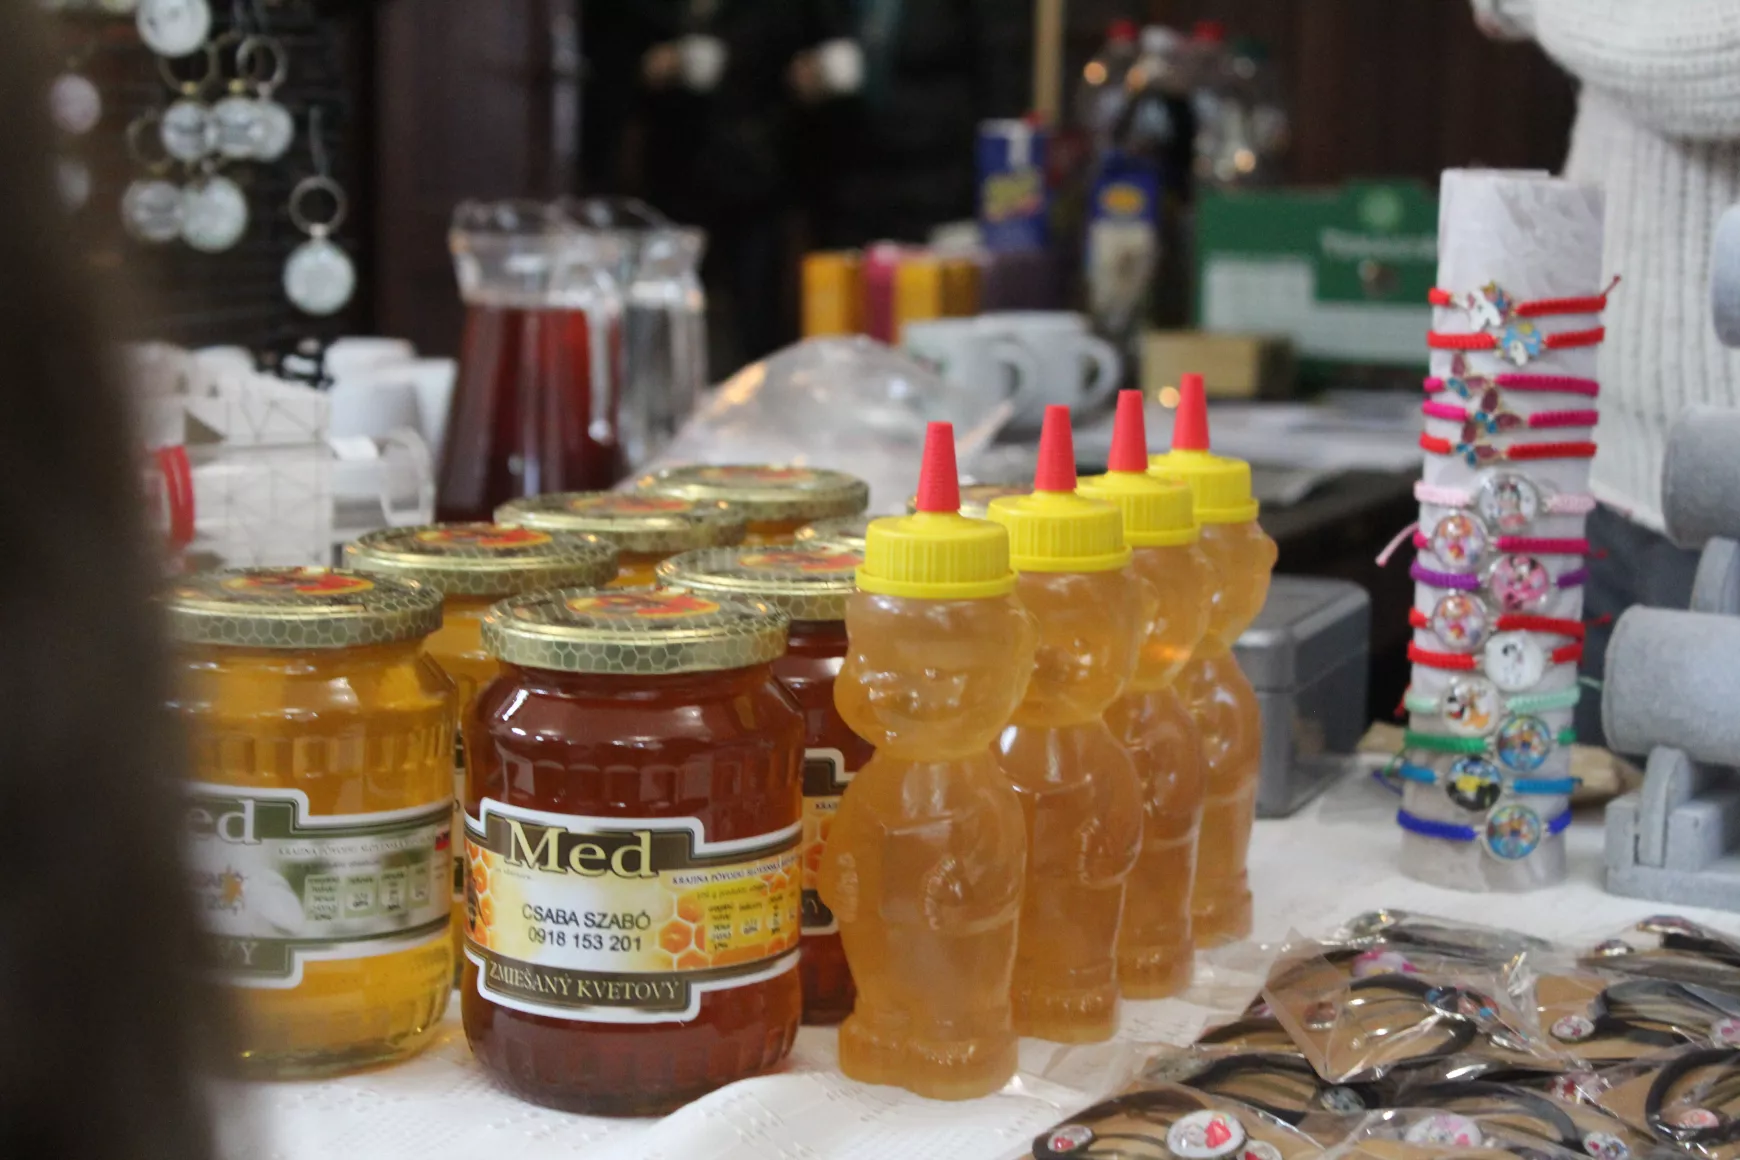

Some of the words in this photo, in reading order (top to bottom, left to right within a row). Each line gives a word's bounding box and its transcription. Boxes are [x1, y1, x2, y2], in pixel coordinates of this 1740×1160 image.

[184, 797, 262, 845] ed
[503, 817, 660, 879] Med
[522, 903, 580, 926] CSABA
[583, 908, 651, 931] SZABÓ
[528, 925, 567, 948] 0918
[572, 933, 604, 950] 153
[609, 935, 642, 952] 201
[489, 959, 573, 997] ZMIEŠANÝ
[577, 975, 681, 1001] KVETOVÝ
